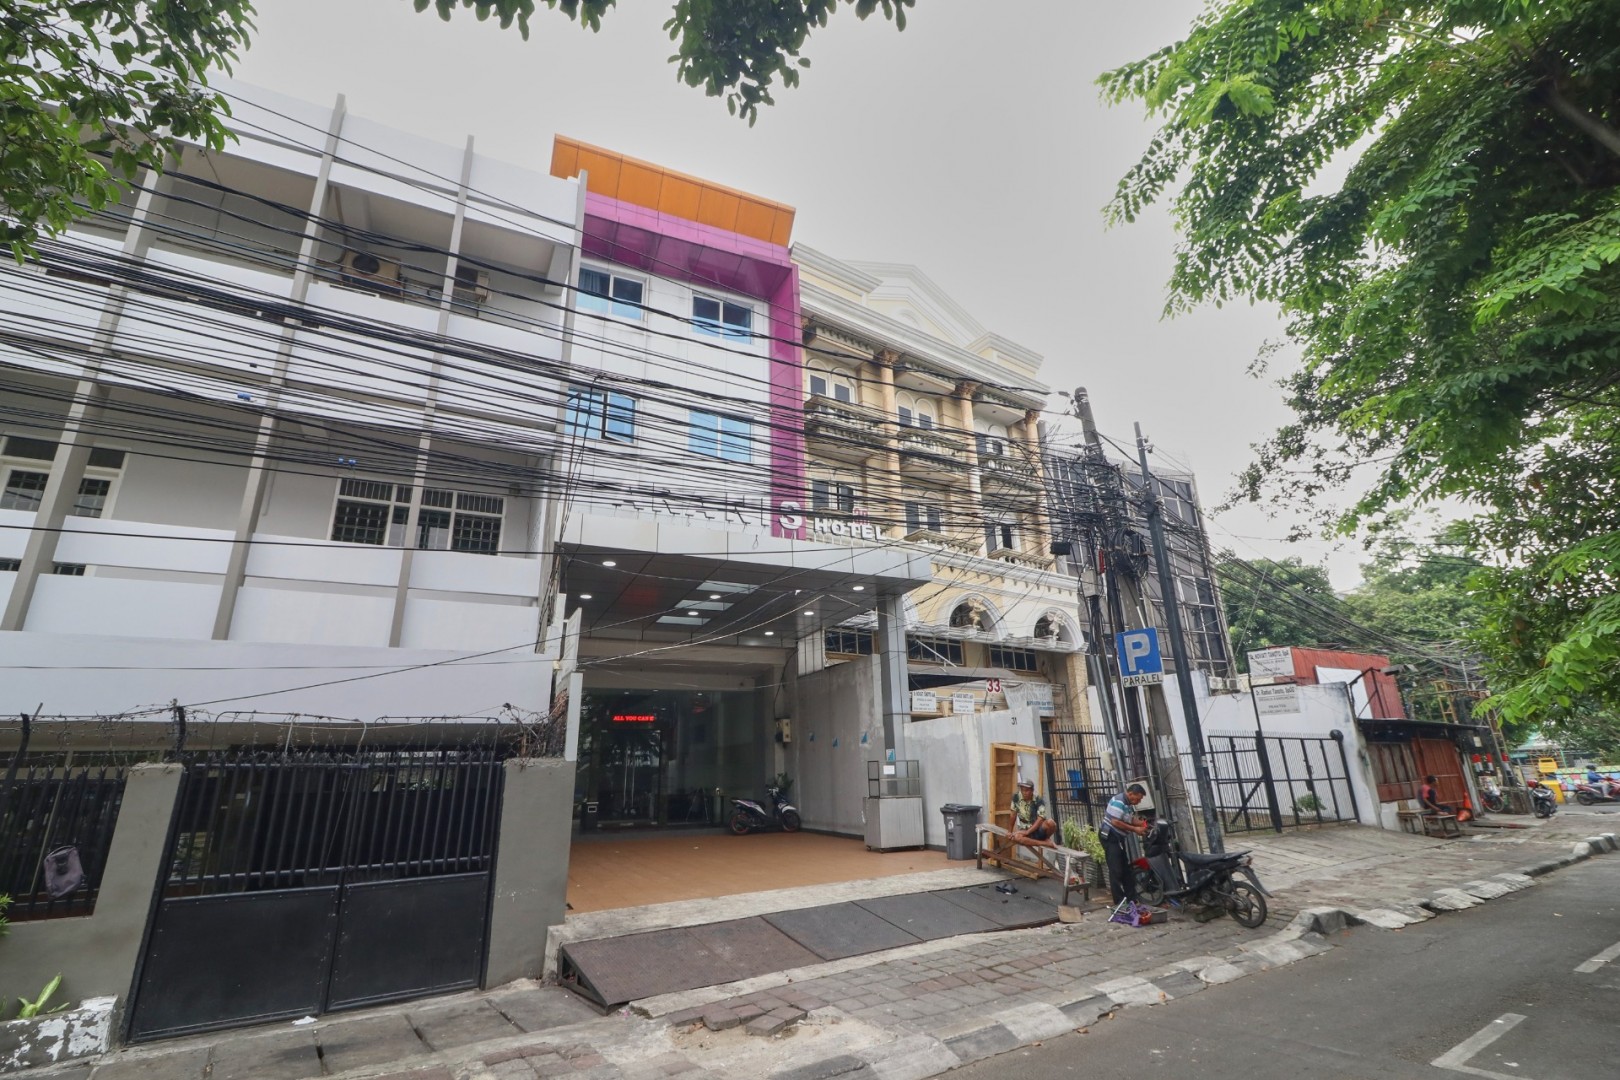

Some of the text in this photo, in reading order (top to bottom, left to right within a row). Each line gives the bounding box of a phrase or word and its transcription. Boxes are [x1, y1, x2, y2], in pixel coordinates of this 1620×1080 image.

[814, 517, 887, 540] HOTEL
[1124, 633, 1150, 672] P
[986, 678, 1001, 693] 33
[1123, 674, 1163, 685] PARALEL
